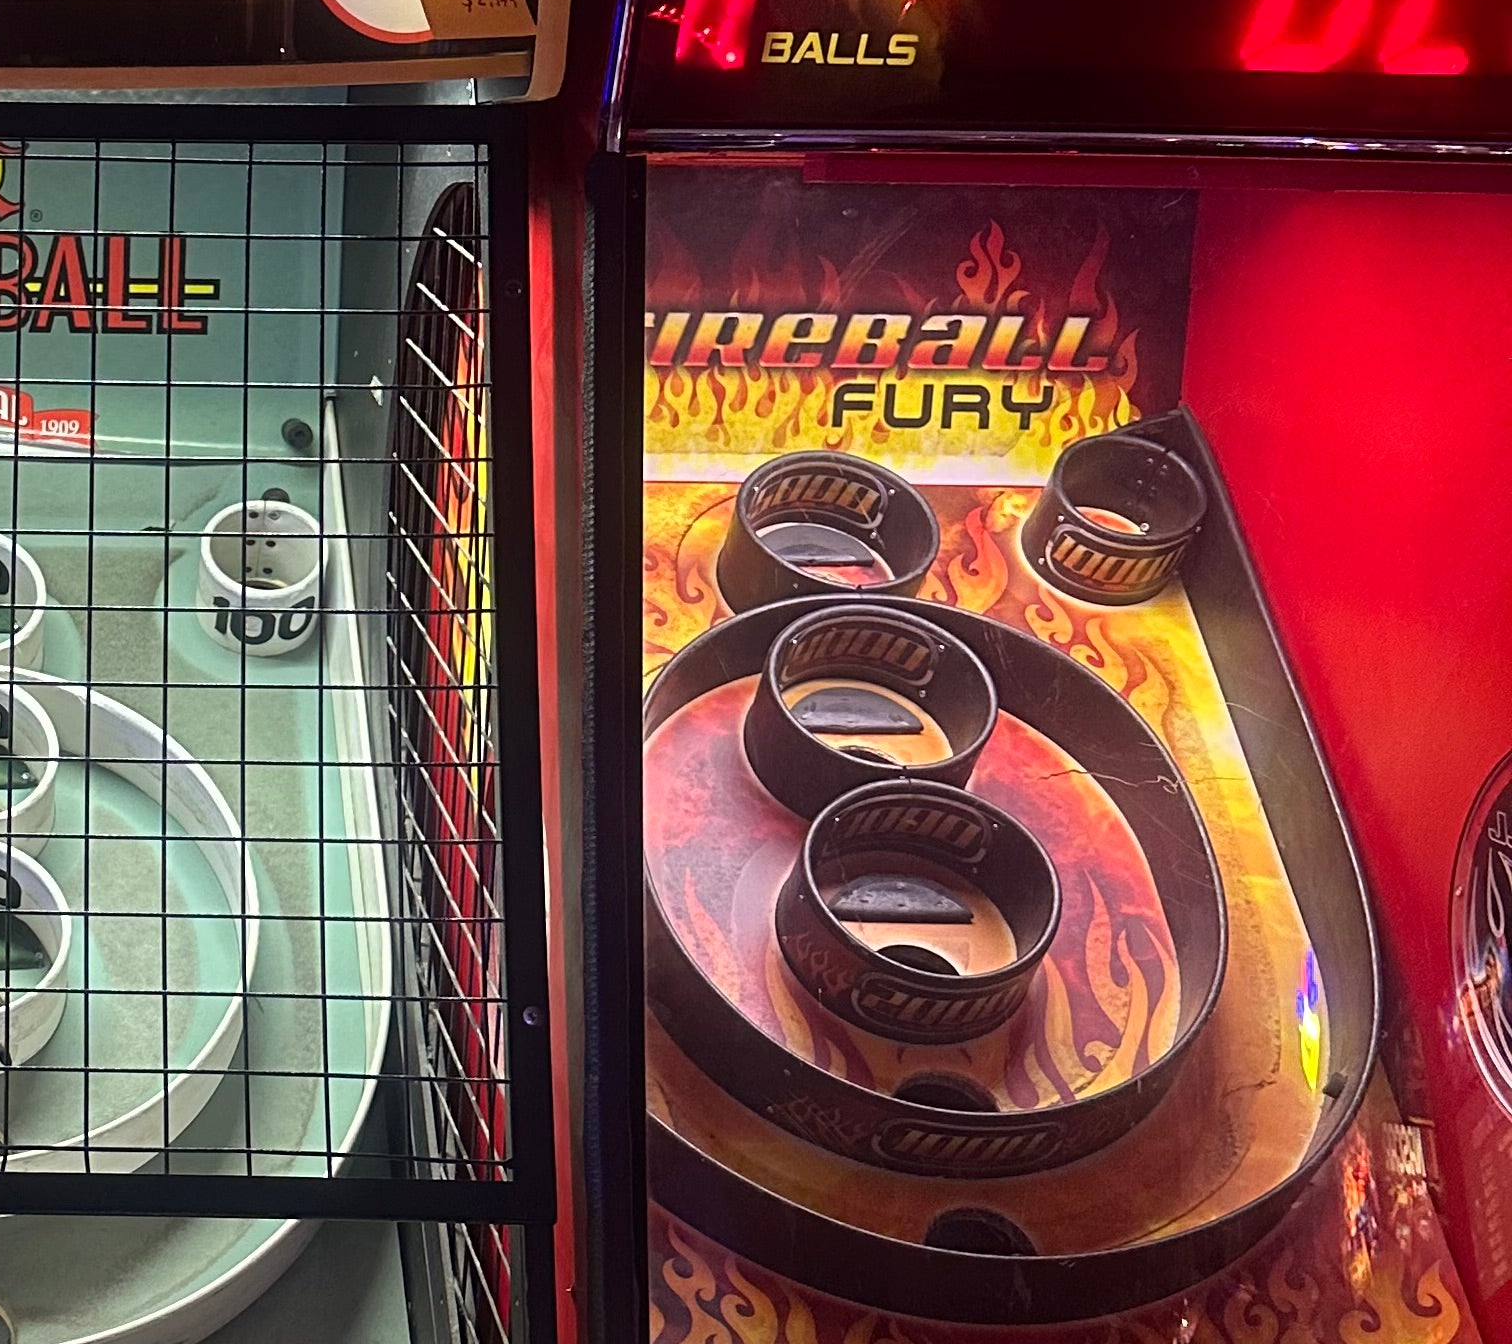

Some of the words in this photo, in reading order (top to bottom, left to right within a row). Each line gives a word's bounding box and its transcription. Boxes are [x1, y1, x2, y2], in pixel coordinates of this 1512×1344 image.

[760, 31, 920, 66] BALLS
[644, 311, 1110, 373] IREBALL
[39, 419, 81, 436] 1909
[831, 383, 1055, 431] FURY
[213, 595, 316, 646] 100
